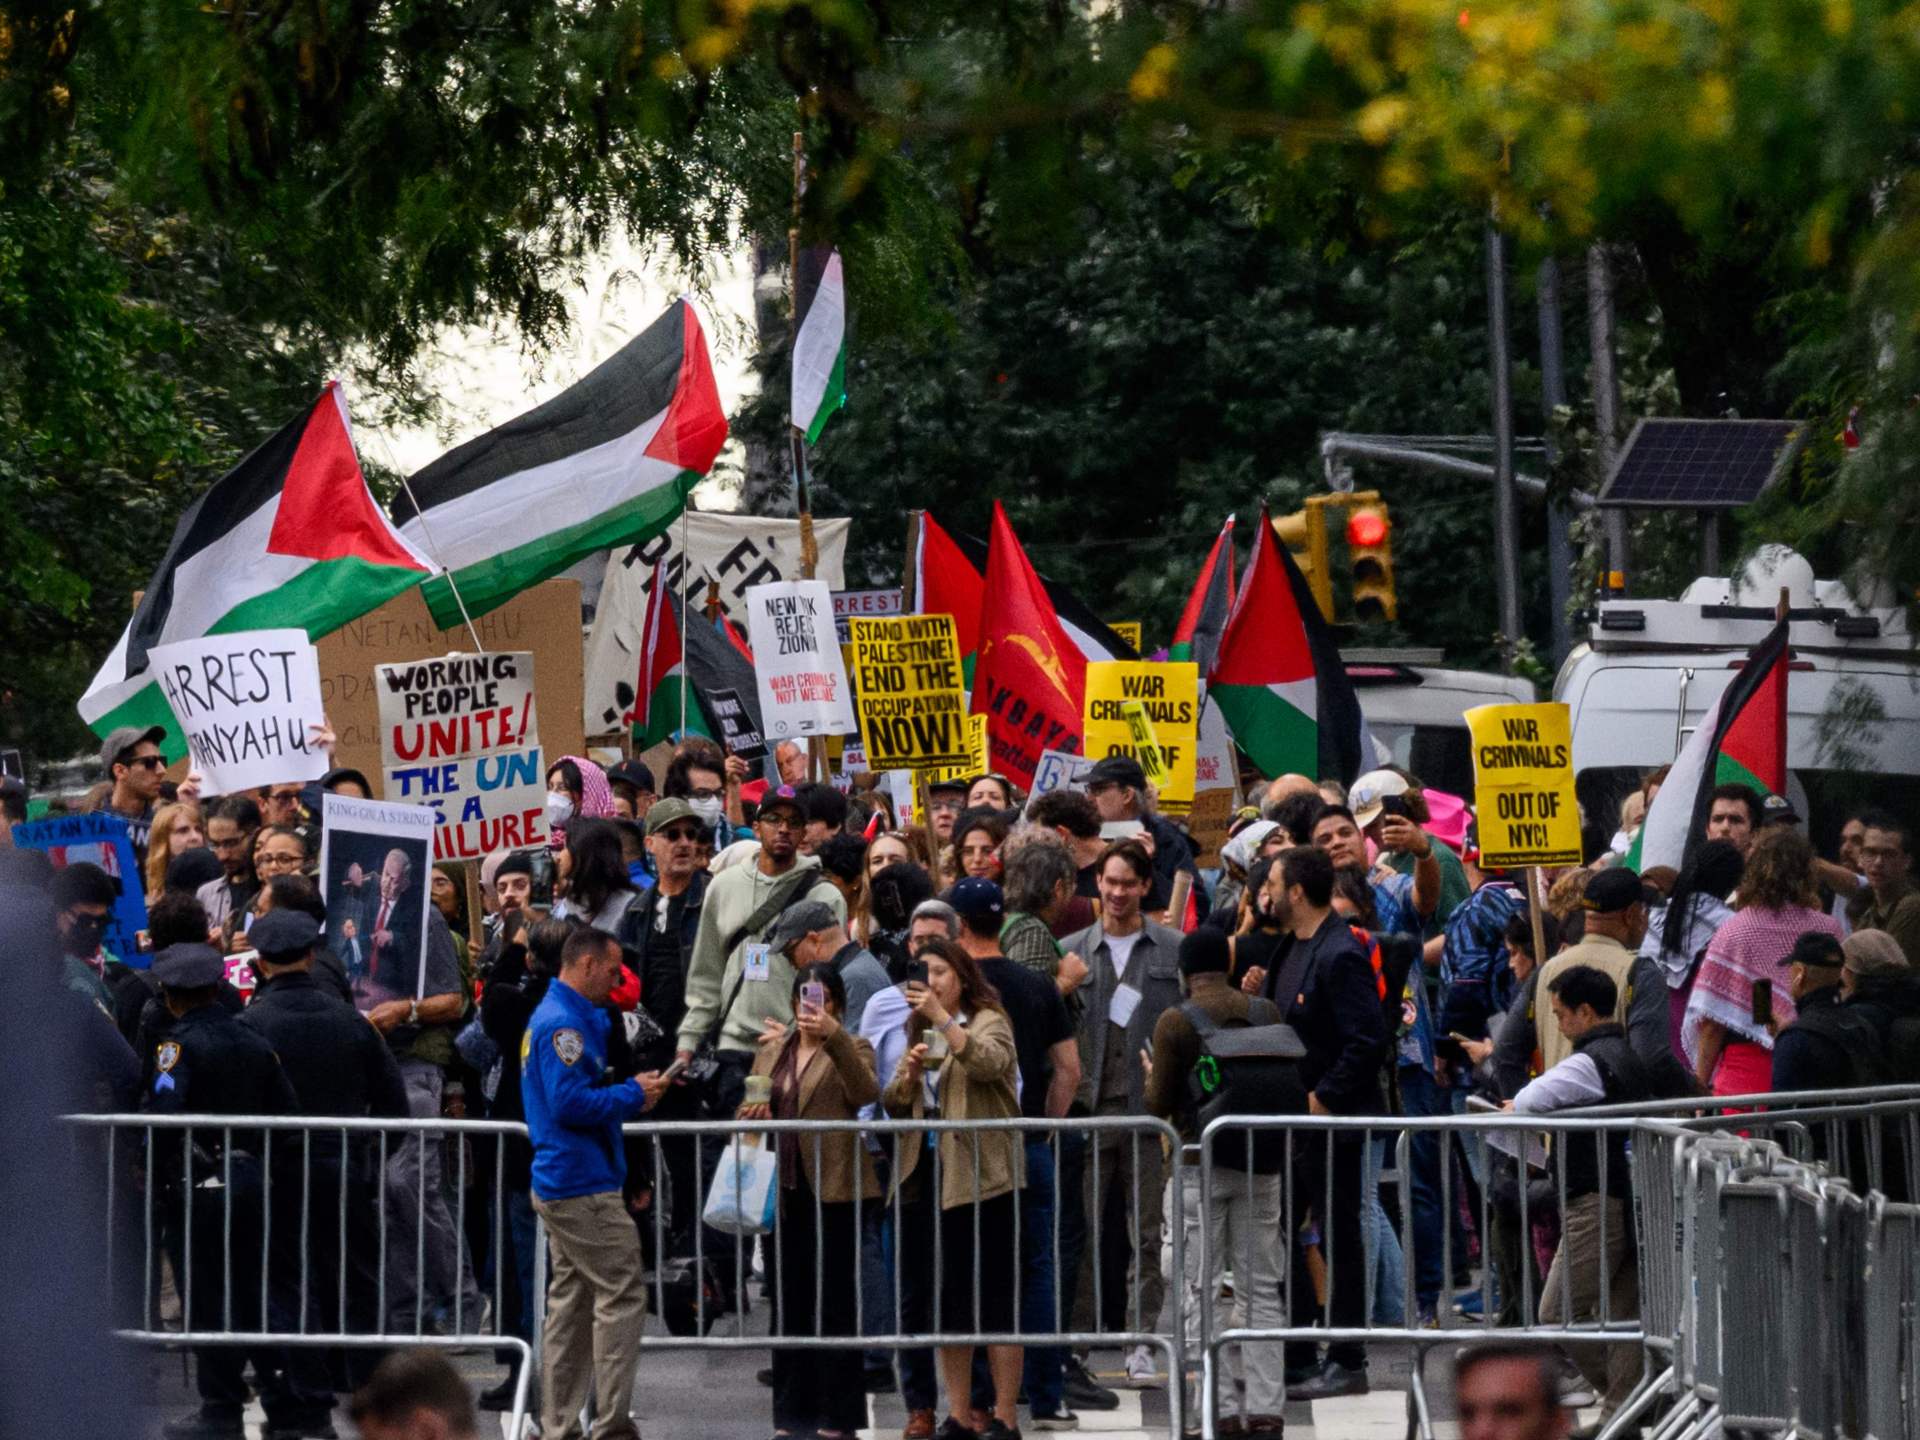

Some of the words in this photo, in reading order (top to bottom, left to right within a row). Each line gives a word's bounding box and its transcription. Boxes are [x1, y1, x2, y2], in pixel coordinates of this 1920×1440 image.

[765, 596, 797, 617] NEW
[834, 594, 900, 613] RREST
[856, 621, 902, 641] STAND
[907, 618, 952, 639] WITH
[858, 638, 954, 664] PALESTINE!
[164, 648, 296, 719] ARREST
[382, 655, 517, 693] WORKING
[769, 673, 795, 690] WAR
[861, 665, 906, 693] END
[911, 661, 959, 690] THE
[1121, 676, 1164, 697] WAR
[405, 682, 499, 719] PEOPLE
[862, 694, 961, 717] OCCUPATION
[1090, 700, 1191, 724] CRINALS
[393, 692, 532, 761] UNITE!
[866, 713, 965, 757] NOW!
[392, 763, 460, 796] THE
[476, 749, 540, 791] UN
[328, 801, 357, 817] KING
[389, 811, 431, 826] STRING
[462, 795, 485, 822] A
[1498, 793, 1535, 820] OUT
[1538, 791, 1561, 818] OF
[434, 807, 546, 860] ILURE
[1508, 824, 1549, 848] NYC!
